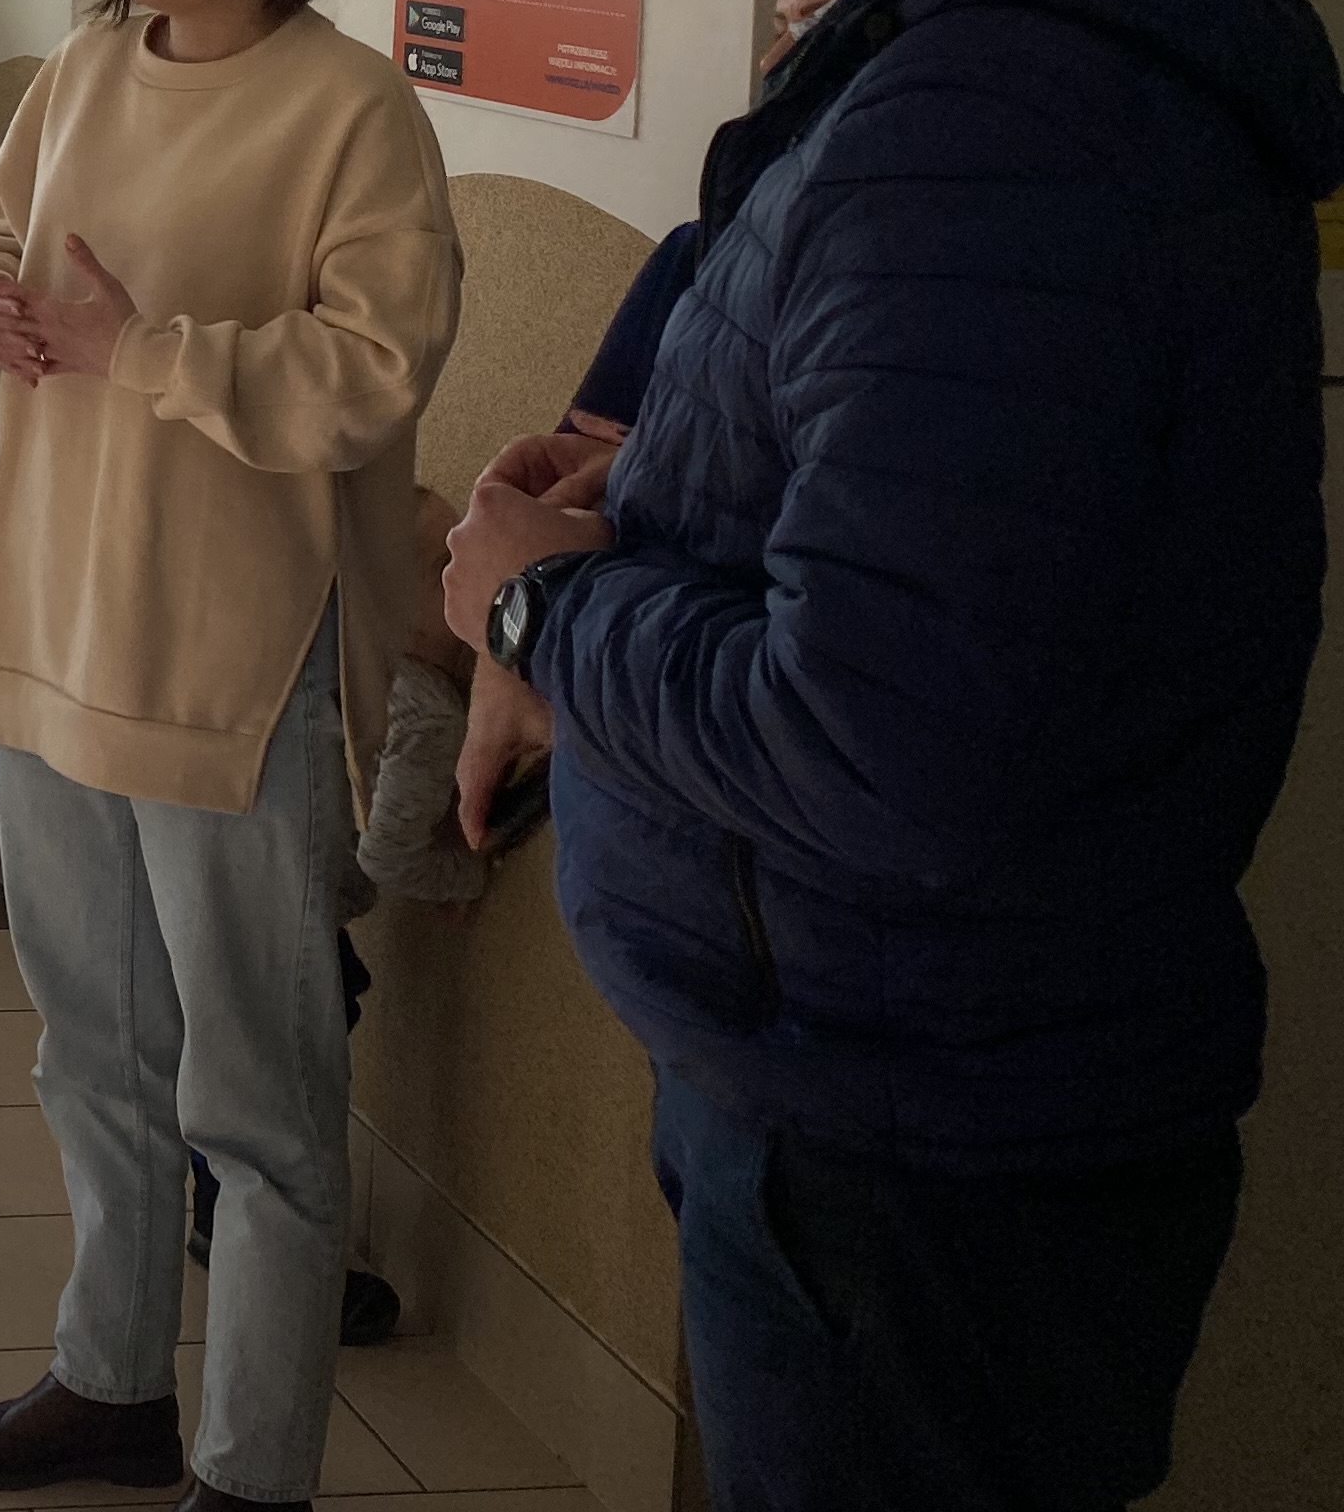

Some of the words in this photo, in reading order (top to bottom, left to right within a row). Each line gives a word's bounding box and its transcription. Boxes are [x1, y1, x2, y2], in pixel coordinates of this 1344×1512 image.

[422, 16, 445, 35] Google
[446, 20, 460, 37] Play
[420, 60, 436, 76] App
[436, 63, 458, 80] Store
